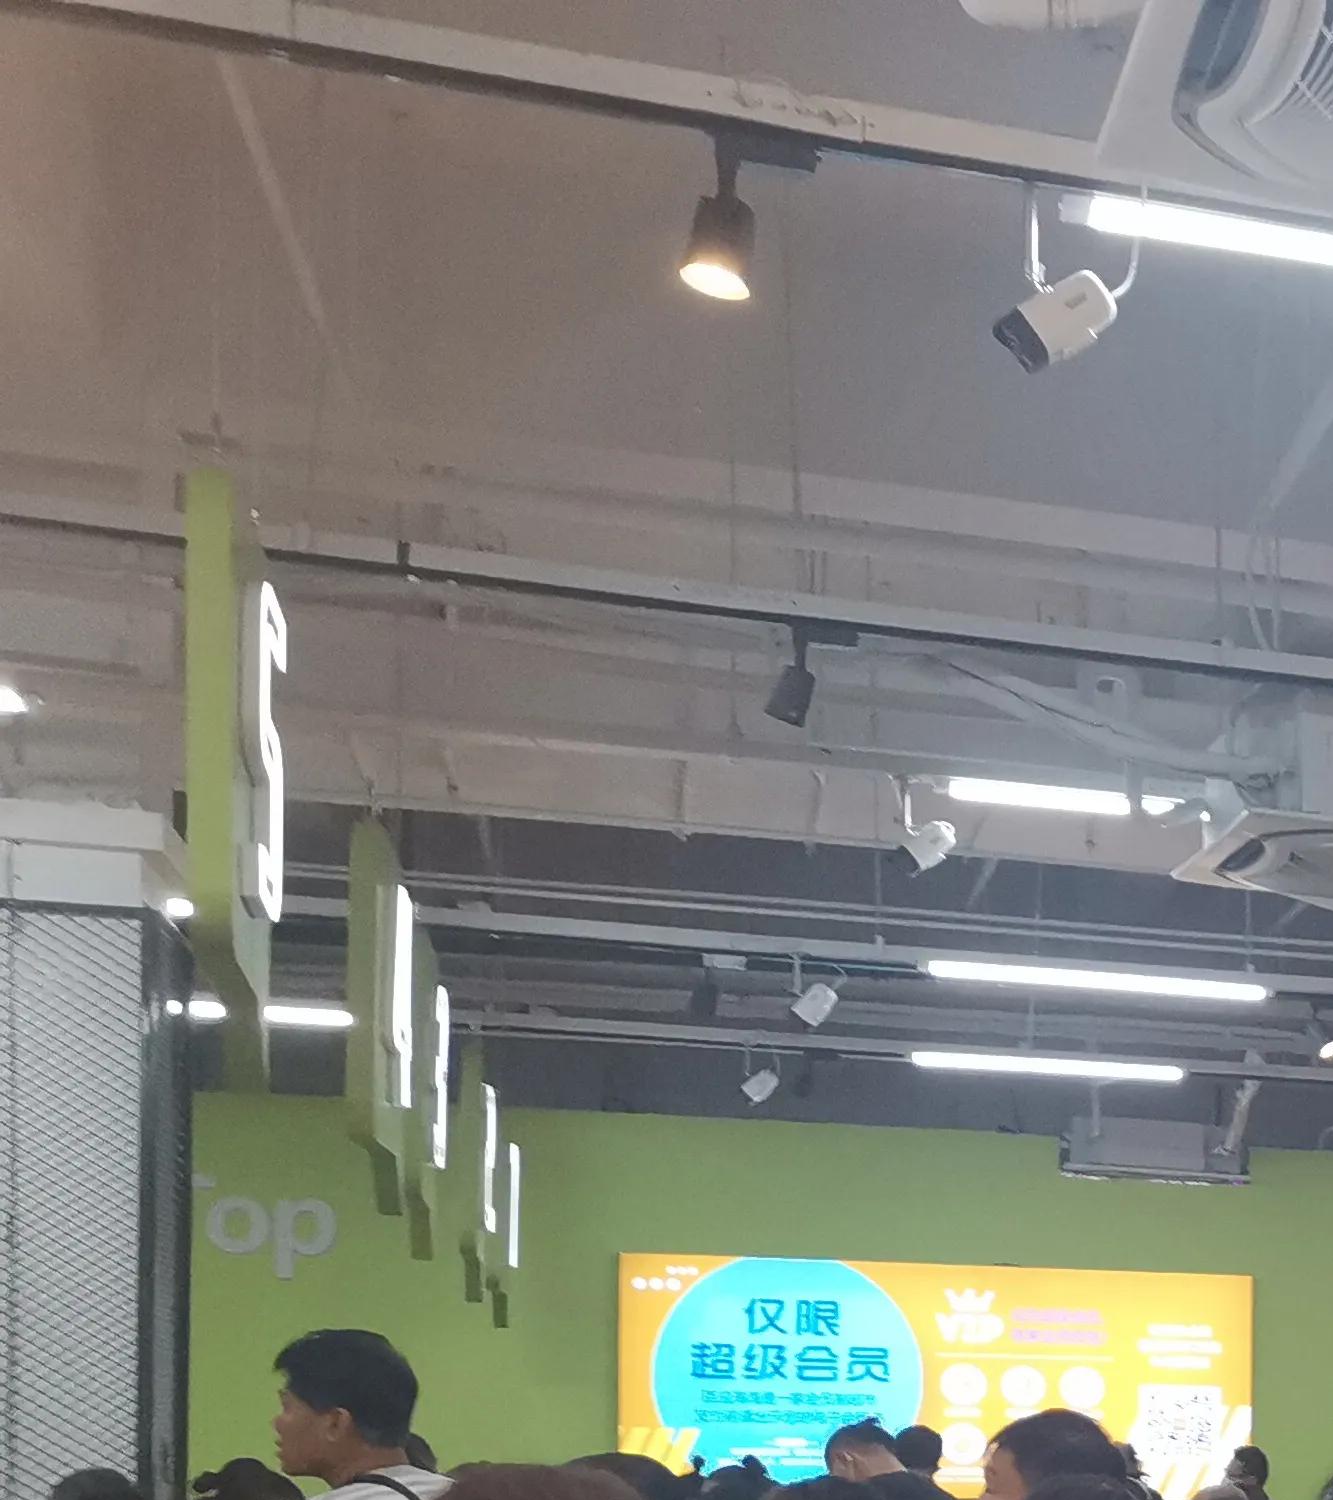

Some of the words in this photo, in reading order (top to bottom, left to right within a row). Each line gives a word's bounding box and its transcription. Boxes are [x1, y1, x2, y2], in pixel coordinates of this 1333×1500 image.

[192, 1173, 337, 1280] op
[744, 1297, 841, 1336] 仅限
[689, 1341, 890, 1383] 超级会员
